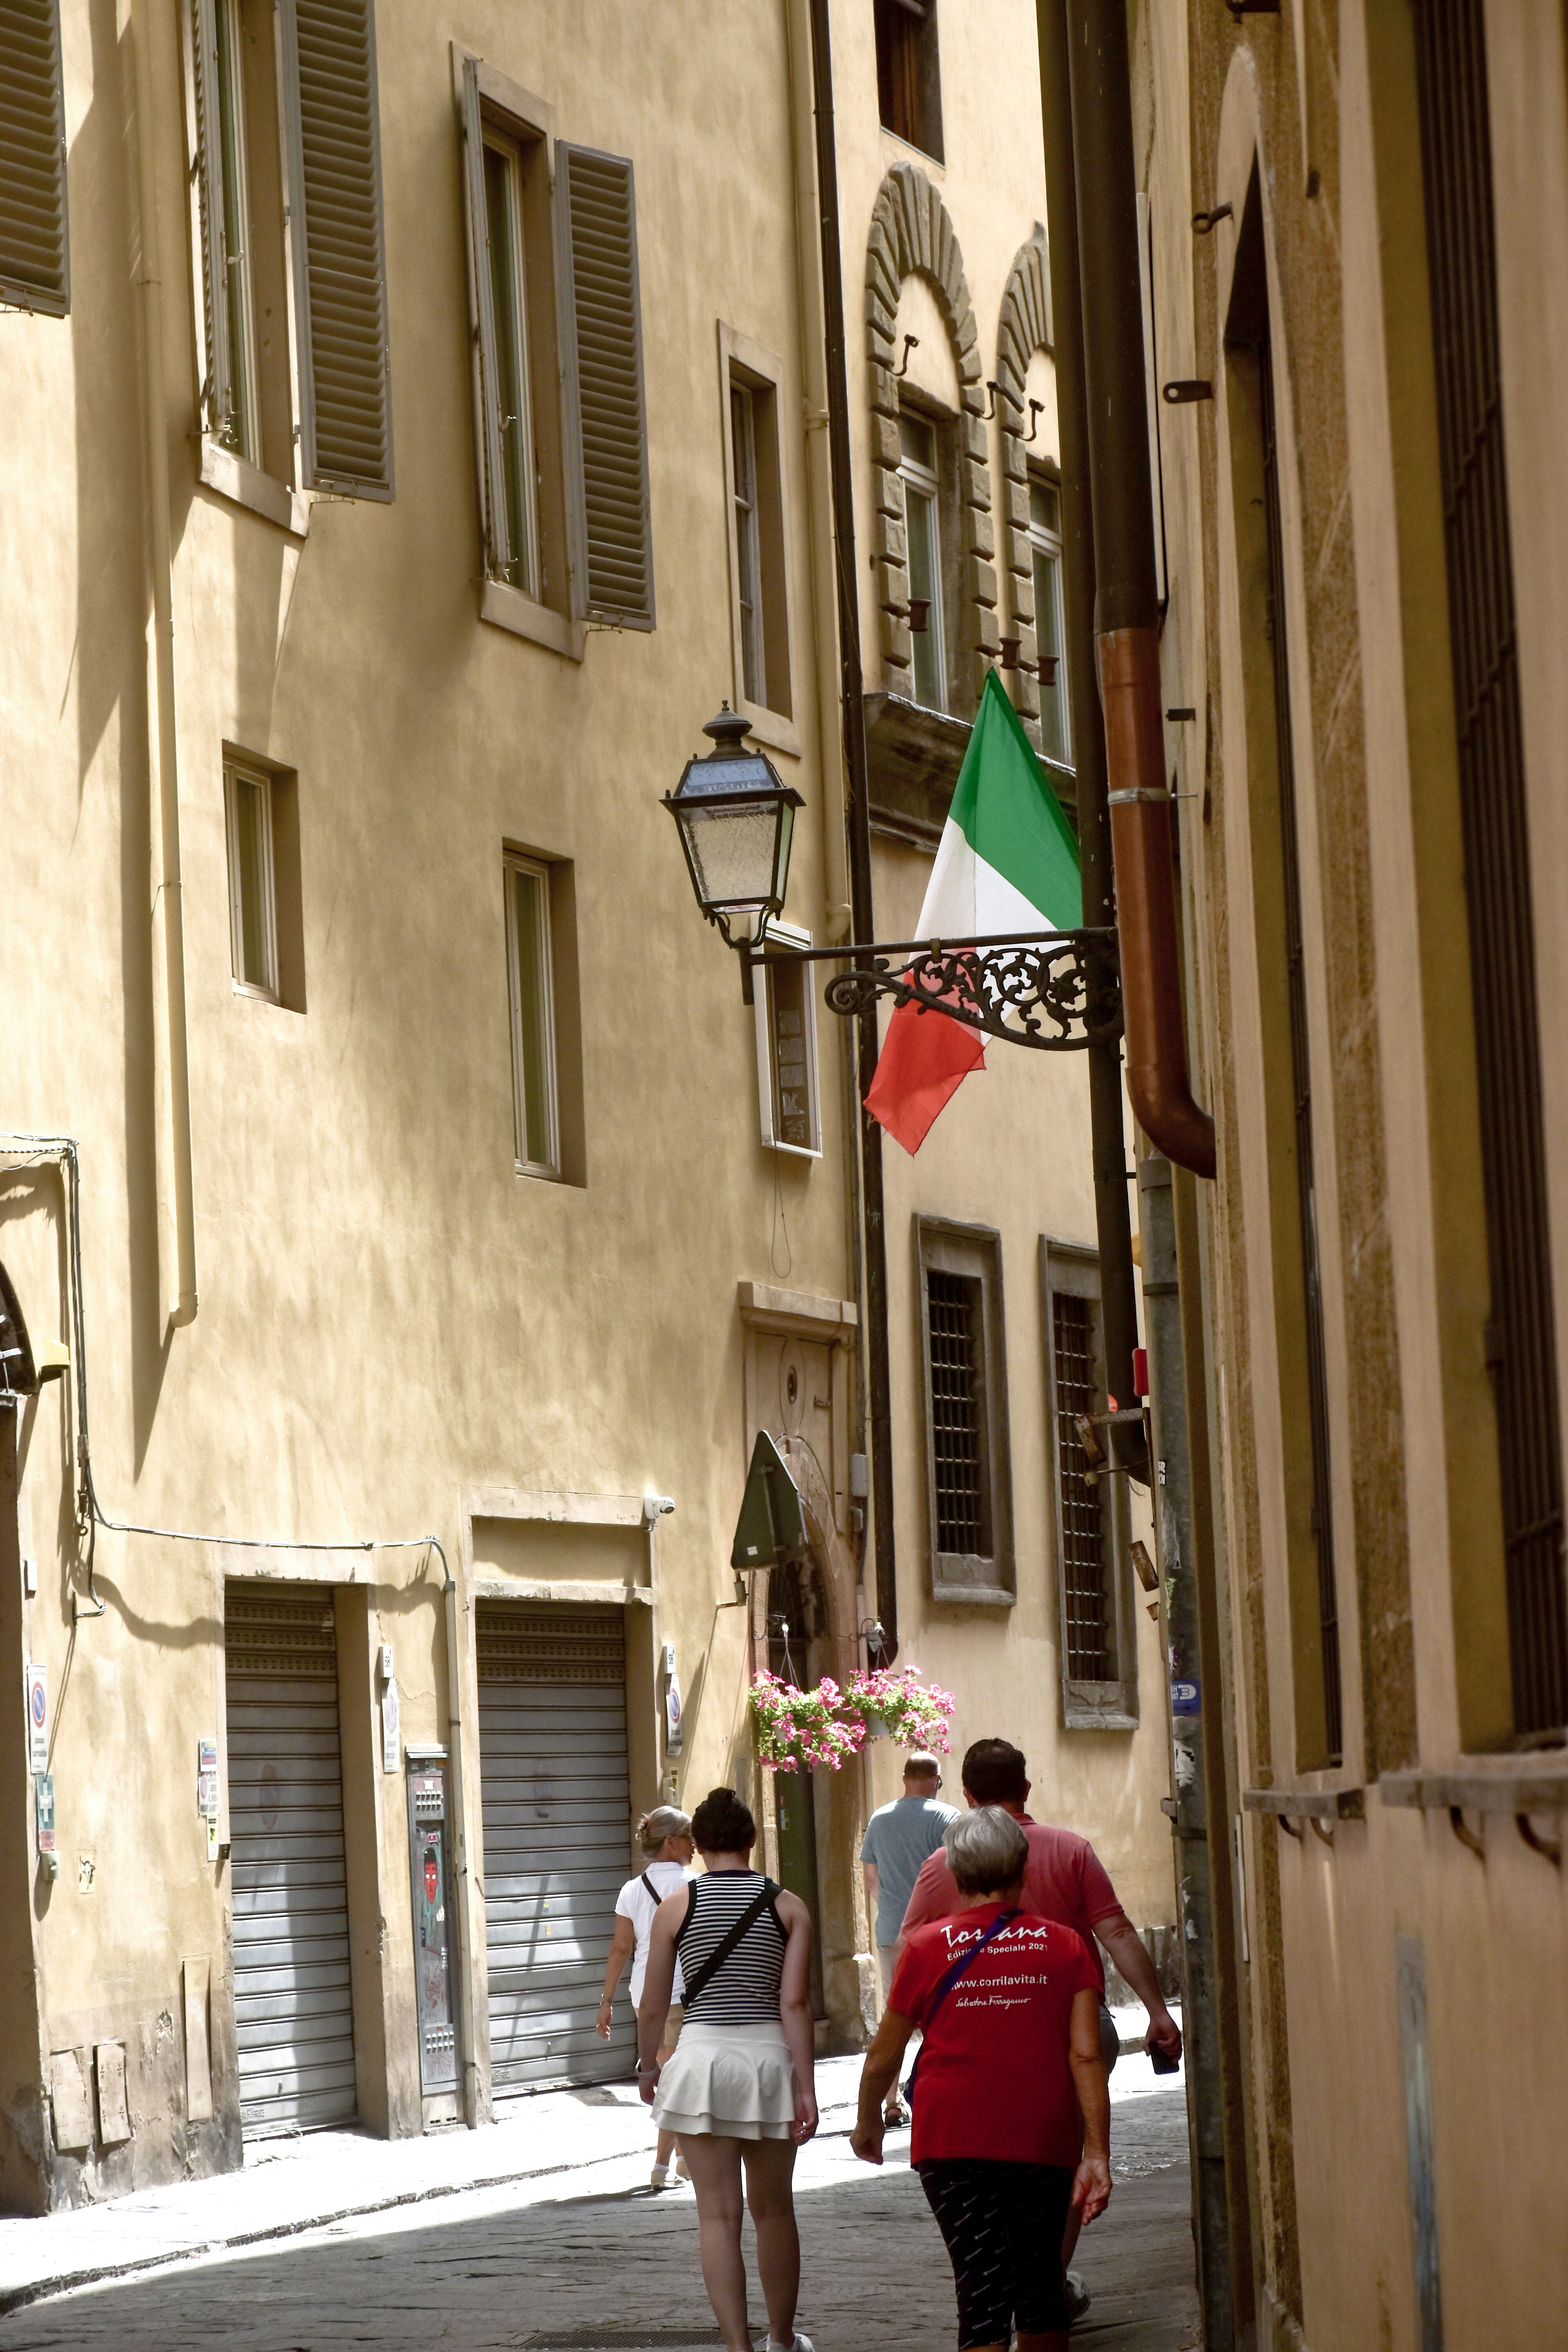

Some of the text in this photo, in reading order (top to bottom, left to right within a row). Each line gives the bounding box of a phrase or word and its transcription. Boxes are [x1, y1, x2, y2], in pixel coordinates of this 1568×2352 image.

[385, 1656, 390, 1667] 58
[668, 1654, 673, 1664] 58
[940, 1925, 1048, 1948] Tosana
[947, 1942, 1048, 1961] Edizie Speciale 2021
[956, 1995, 1031, 2010] Salvatore Ferragamo
